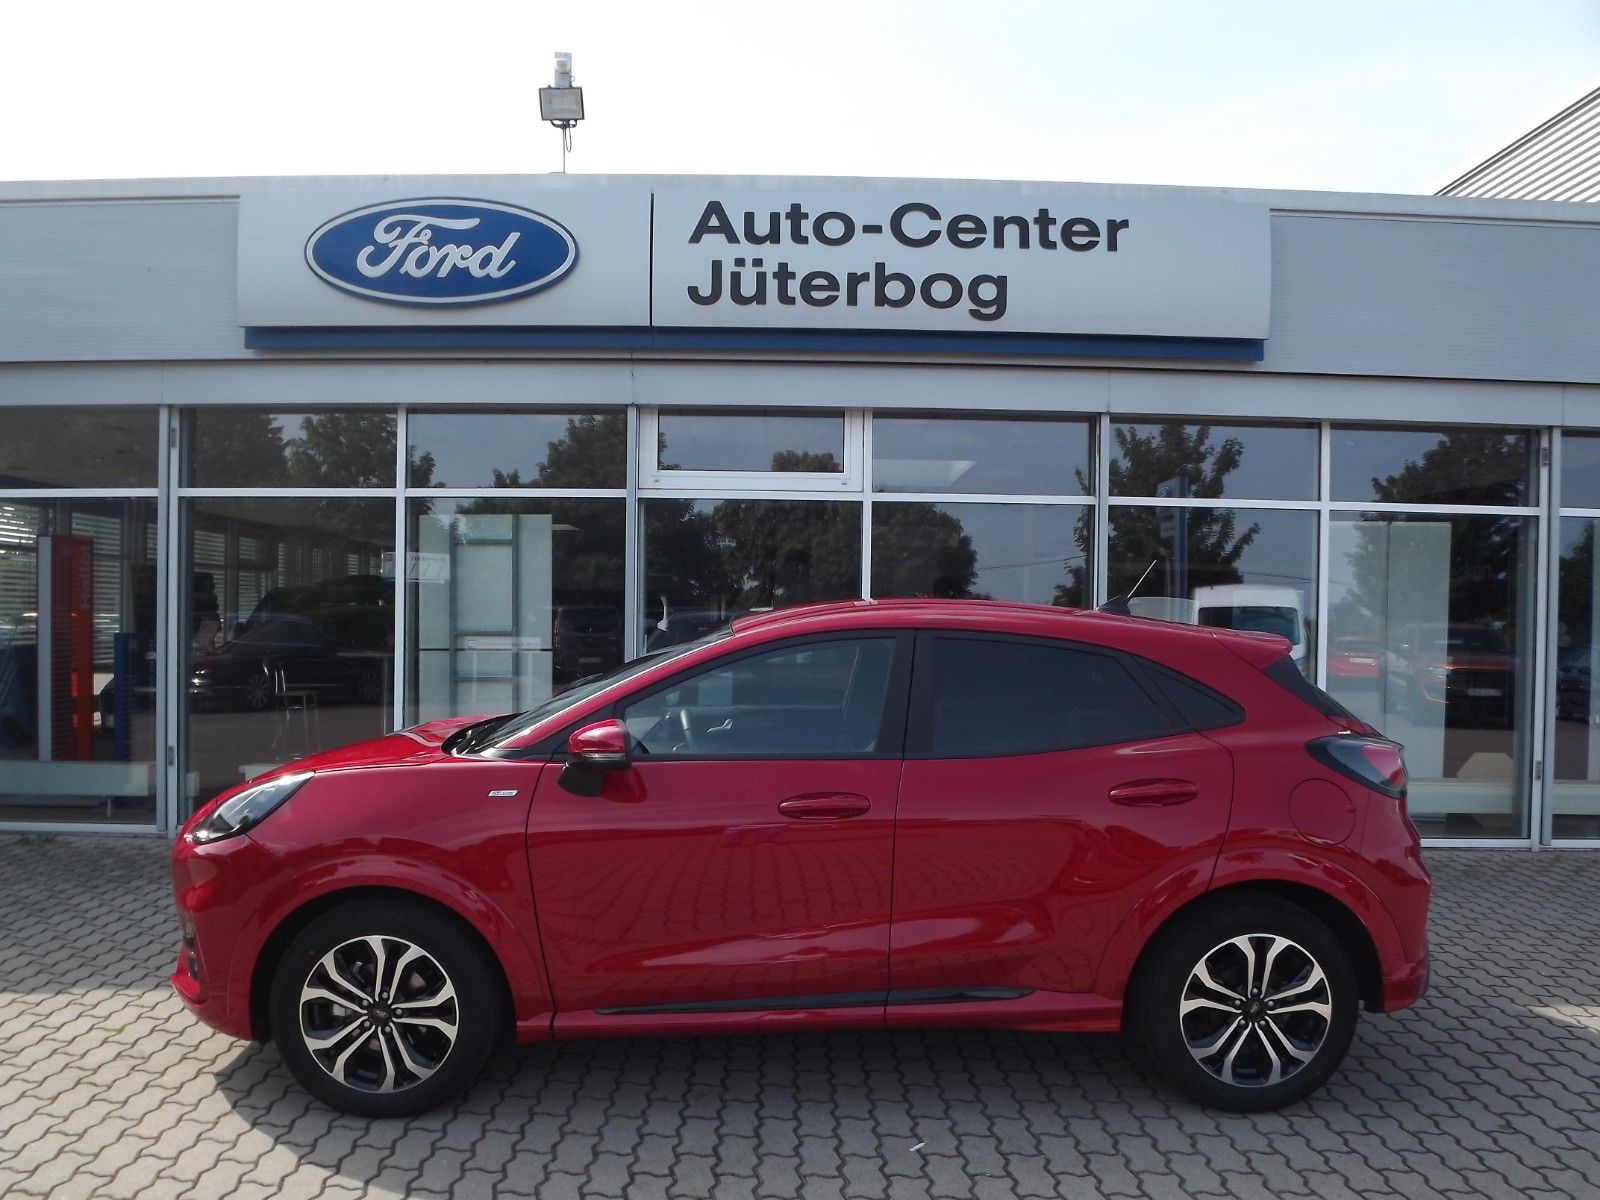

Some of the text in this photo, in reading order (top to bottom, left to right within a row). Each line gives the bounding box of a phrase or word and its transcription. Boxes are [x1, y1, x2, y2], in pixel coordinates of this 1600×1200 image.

[356, 214, 521, 279] Ford
[688, 200, 1130, 252] Auto-Center
[687, 257, 1009, 322] Jüterbog
